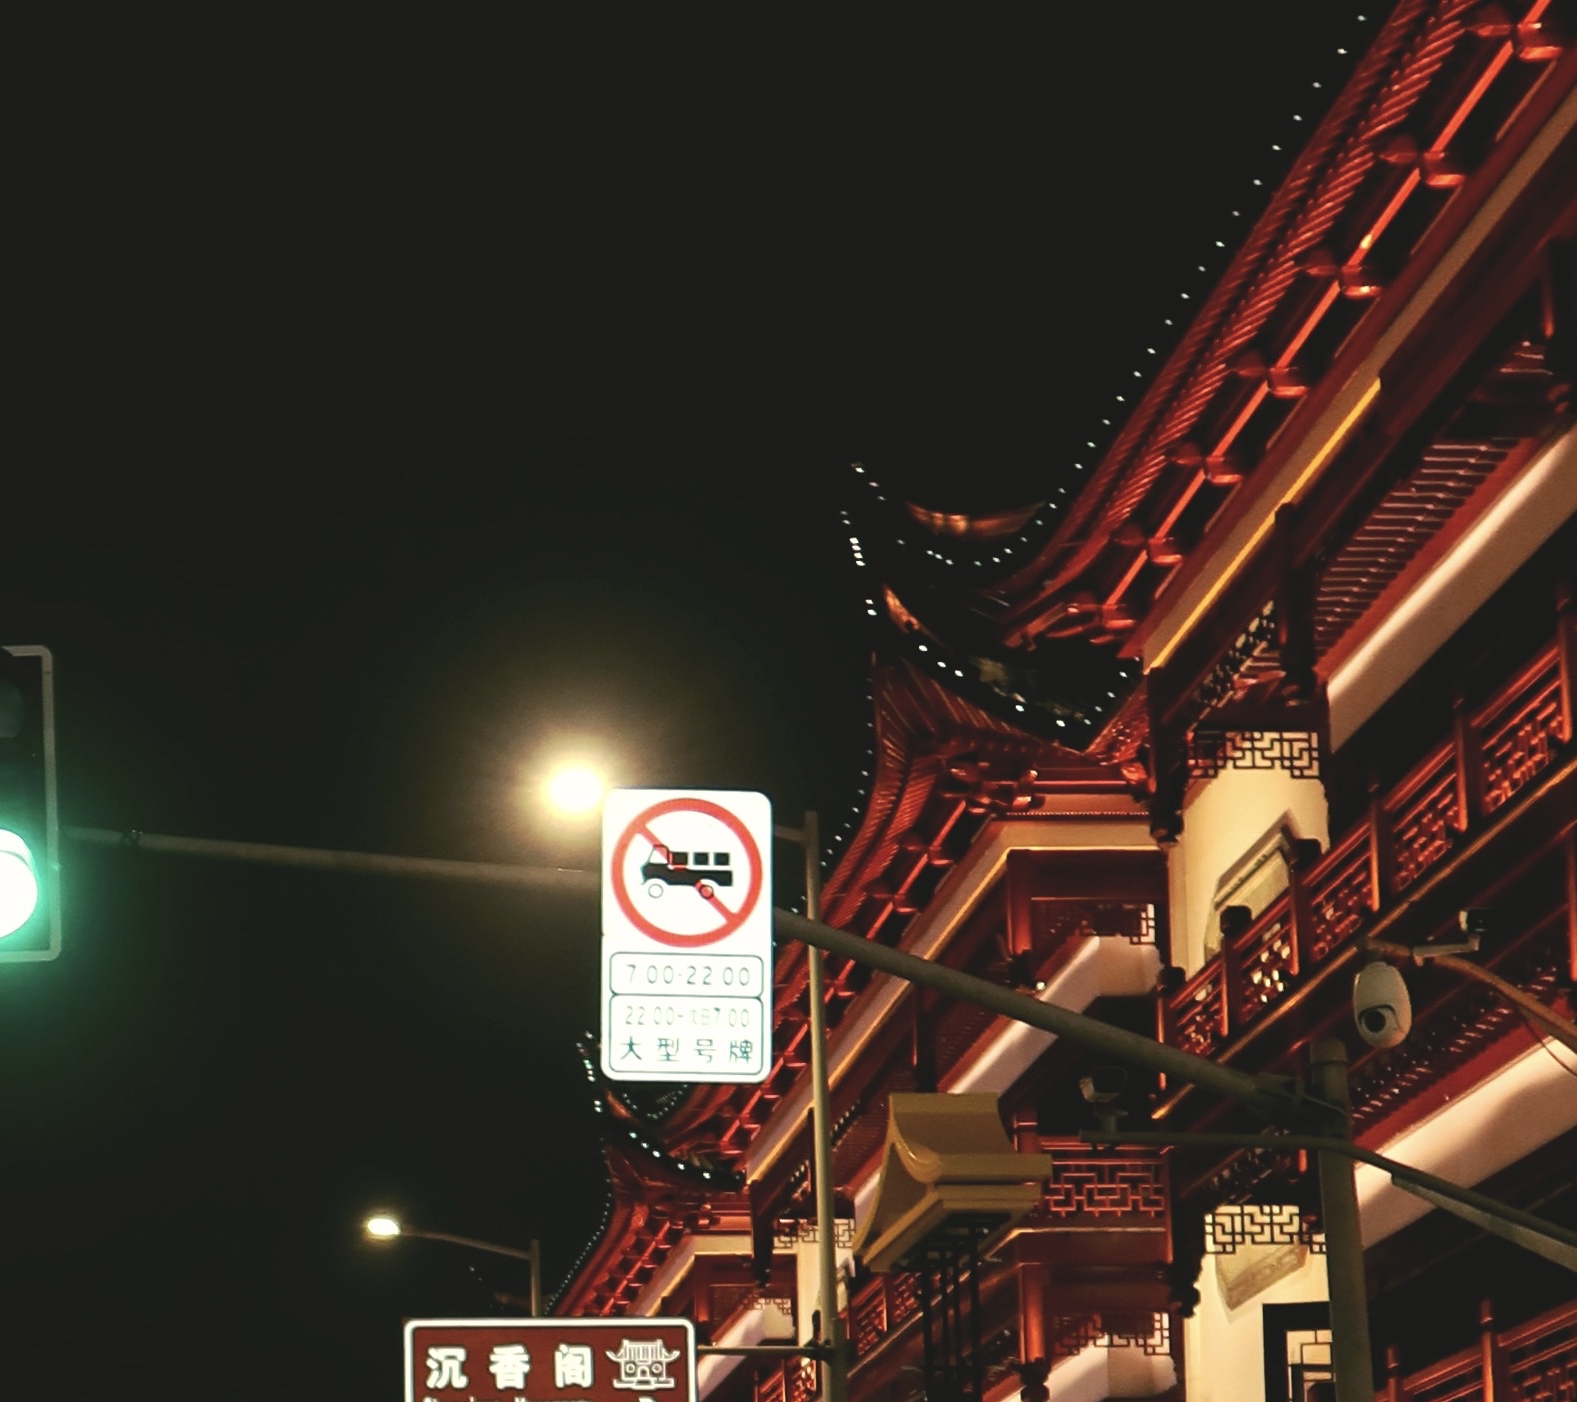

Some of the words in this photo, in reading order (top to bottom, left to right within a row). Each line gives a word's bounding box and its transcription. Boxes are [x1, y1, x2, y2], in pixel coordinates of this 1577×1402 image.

[626, 963, 751, 987] 700-2200
[619, 1035, 754, 1065] 大型号牌
[425, 1343, 595, 1390] 沉香阁
